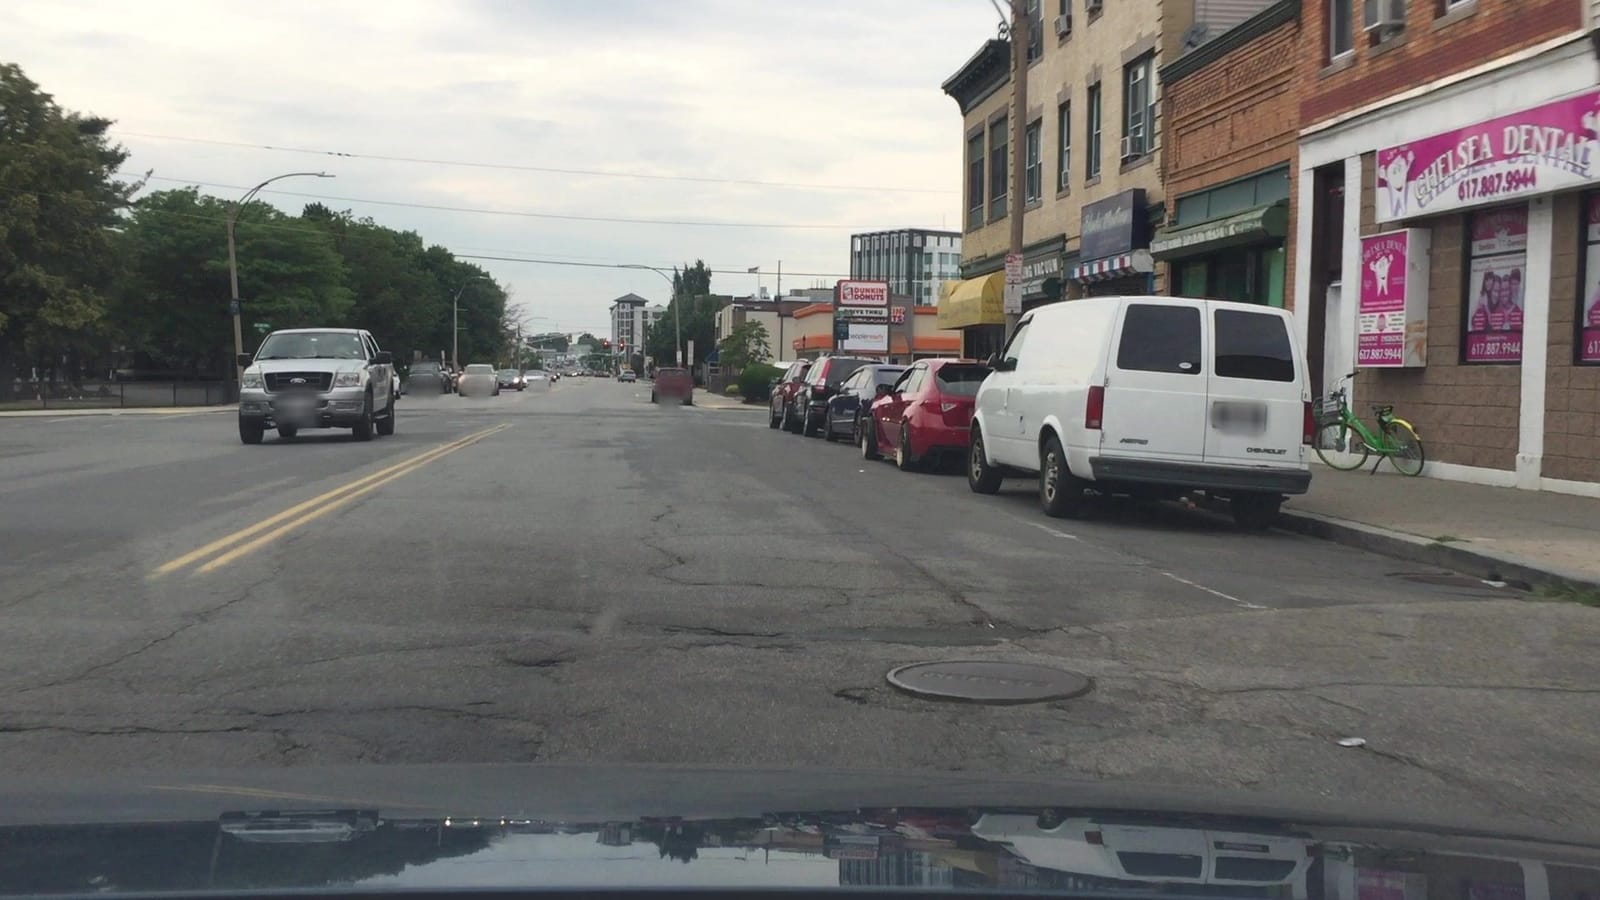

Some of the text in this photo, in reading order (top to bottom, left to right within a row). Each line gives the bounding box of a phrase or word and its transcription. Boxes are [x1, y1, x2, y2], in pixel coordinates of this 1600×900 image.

[1414, 124, 1591, 200] CHELSEA DENTAL
[1458, 166, 1537, 200] 617.887.9944
[1471, 341, 1521, 356] 617.887.9944
